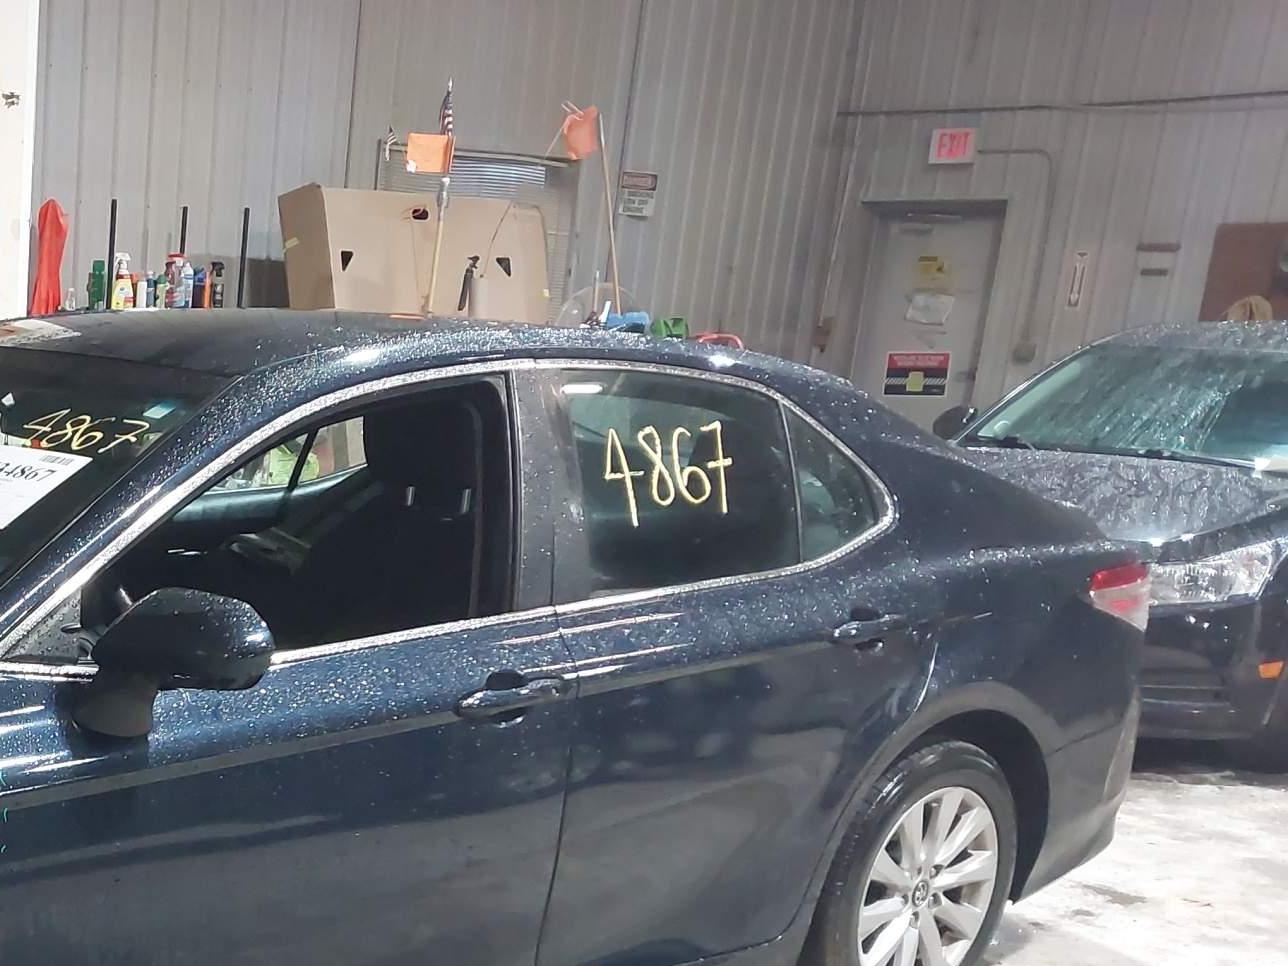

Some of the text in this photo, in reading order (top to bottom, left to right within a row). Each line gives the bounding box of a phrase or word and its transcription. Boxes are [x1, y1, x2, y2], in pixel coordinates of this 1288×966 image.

[937, 132, 969, 158] EXIT
[23, 408, 150, 454] 4867
[605, 420, 733, 528] 4867
